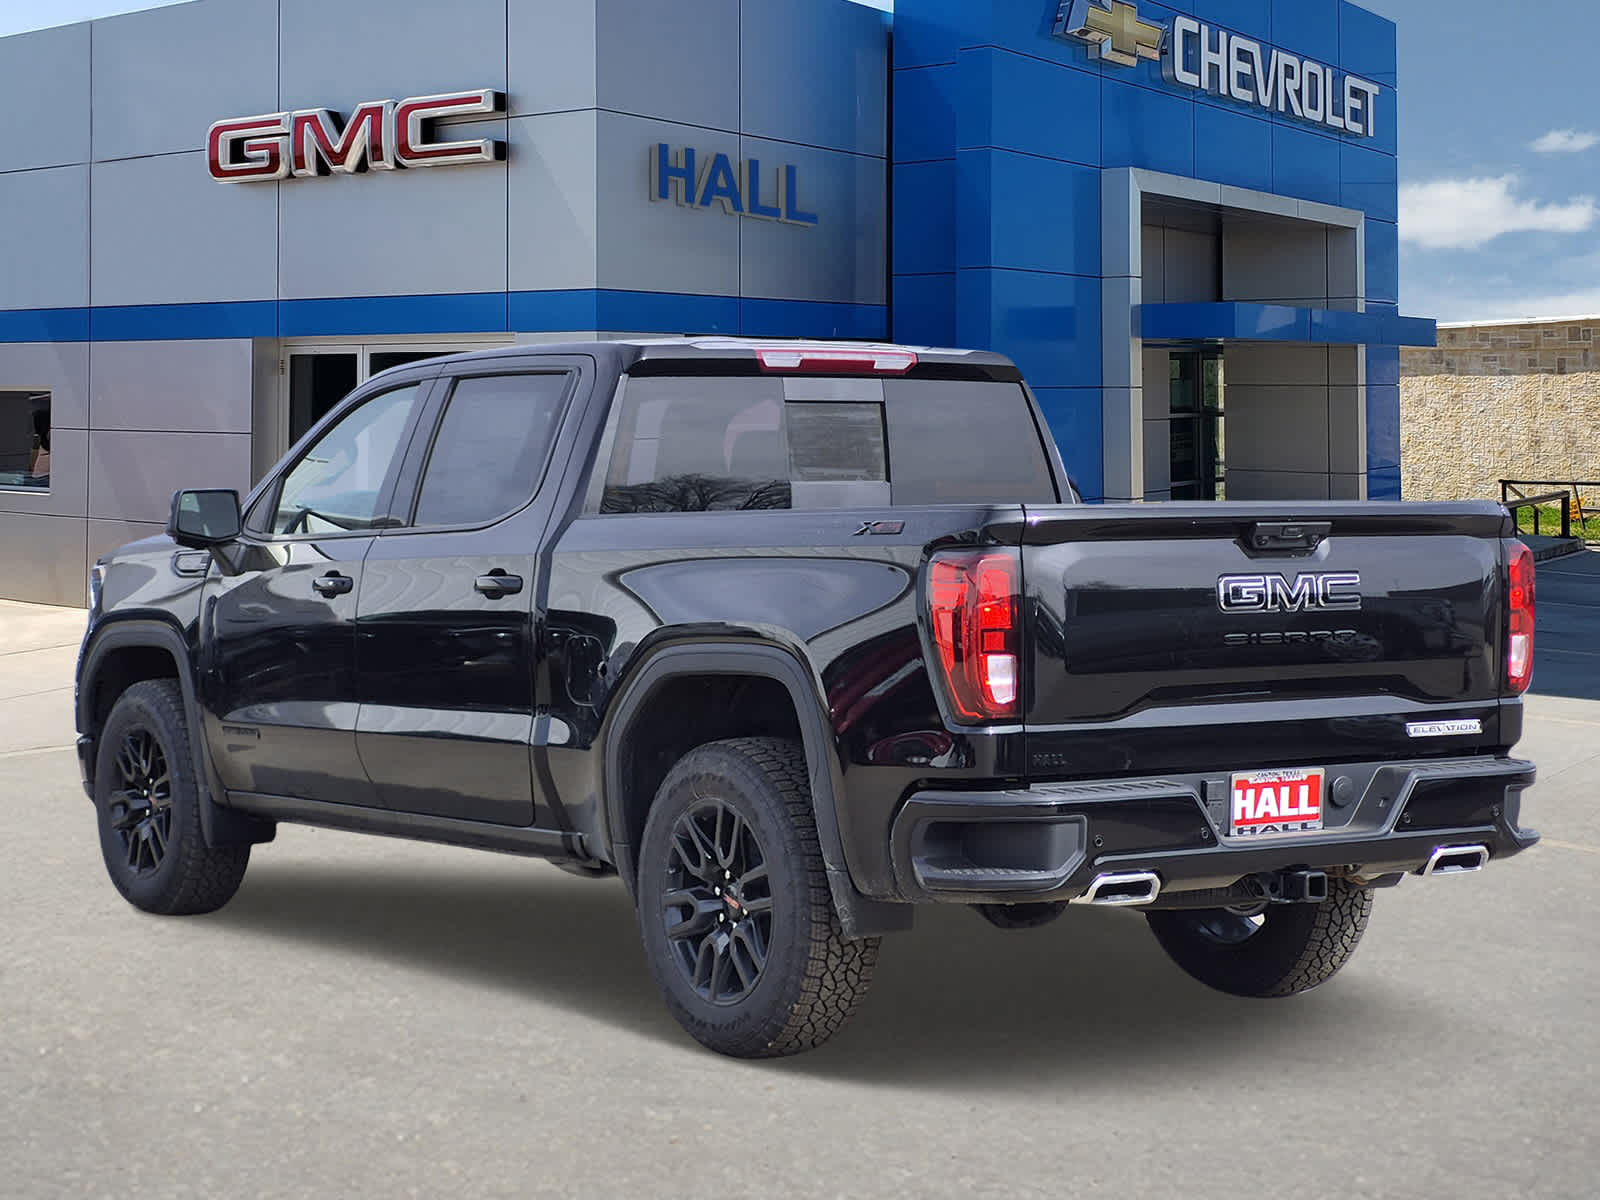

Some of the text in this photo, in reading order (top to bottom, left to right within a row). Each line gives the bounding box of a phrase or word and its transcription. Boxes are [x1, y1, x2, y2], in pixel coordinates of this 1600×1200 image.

[1173, 14, 1380, 138] CHEVROLET
[206, 88, 508, 185] GMC
[650, 142, 818, 228] HALL
[1216, 571, 1362, 614] GMC
[1413, 723, 1477, 734] ELEVATION
[1234, 784, 1320, 820] HALL
[1237, 822, 1318, 835] HALL
